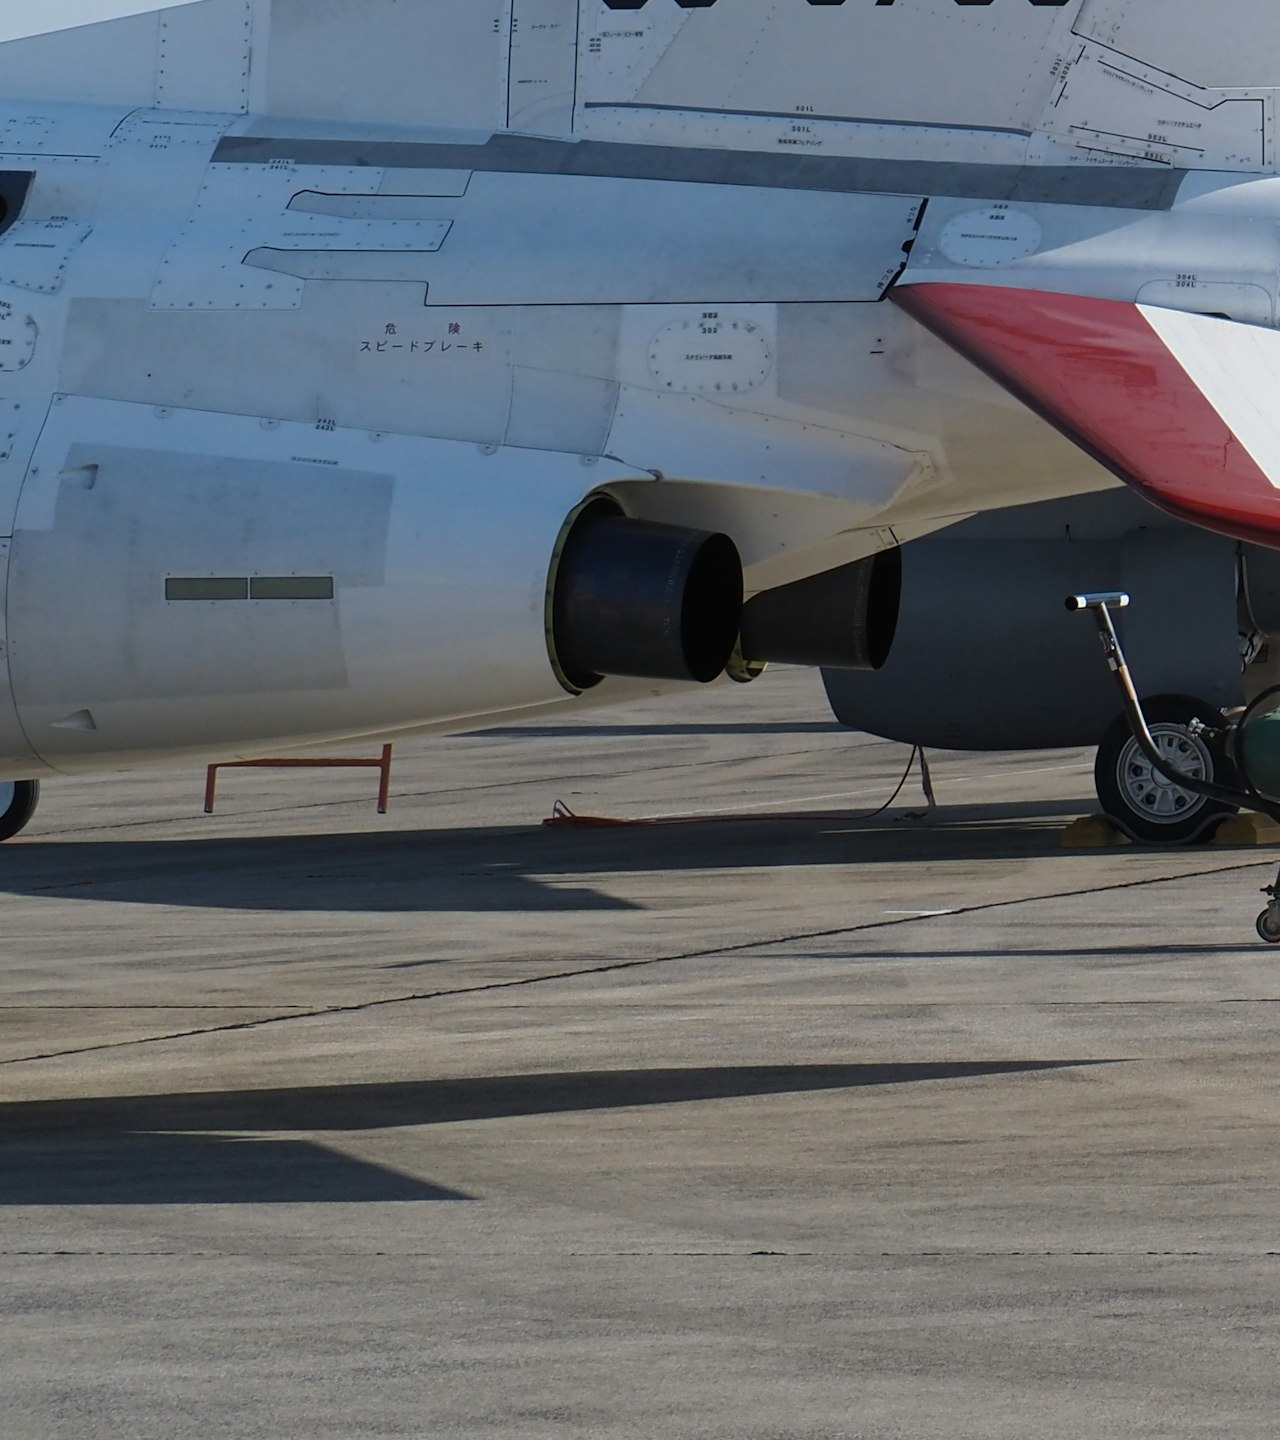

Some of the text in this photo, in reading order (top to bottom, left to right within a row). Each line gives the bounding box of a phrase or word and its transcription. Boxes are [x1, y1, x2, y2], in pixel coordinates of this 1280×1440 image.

[1176, 273, 1196, 281] 304L
[360, 340, 484, 353] スピードブレーキ
